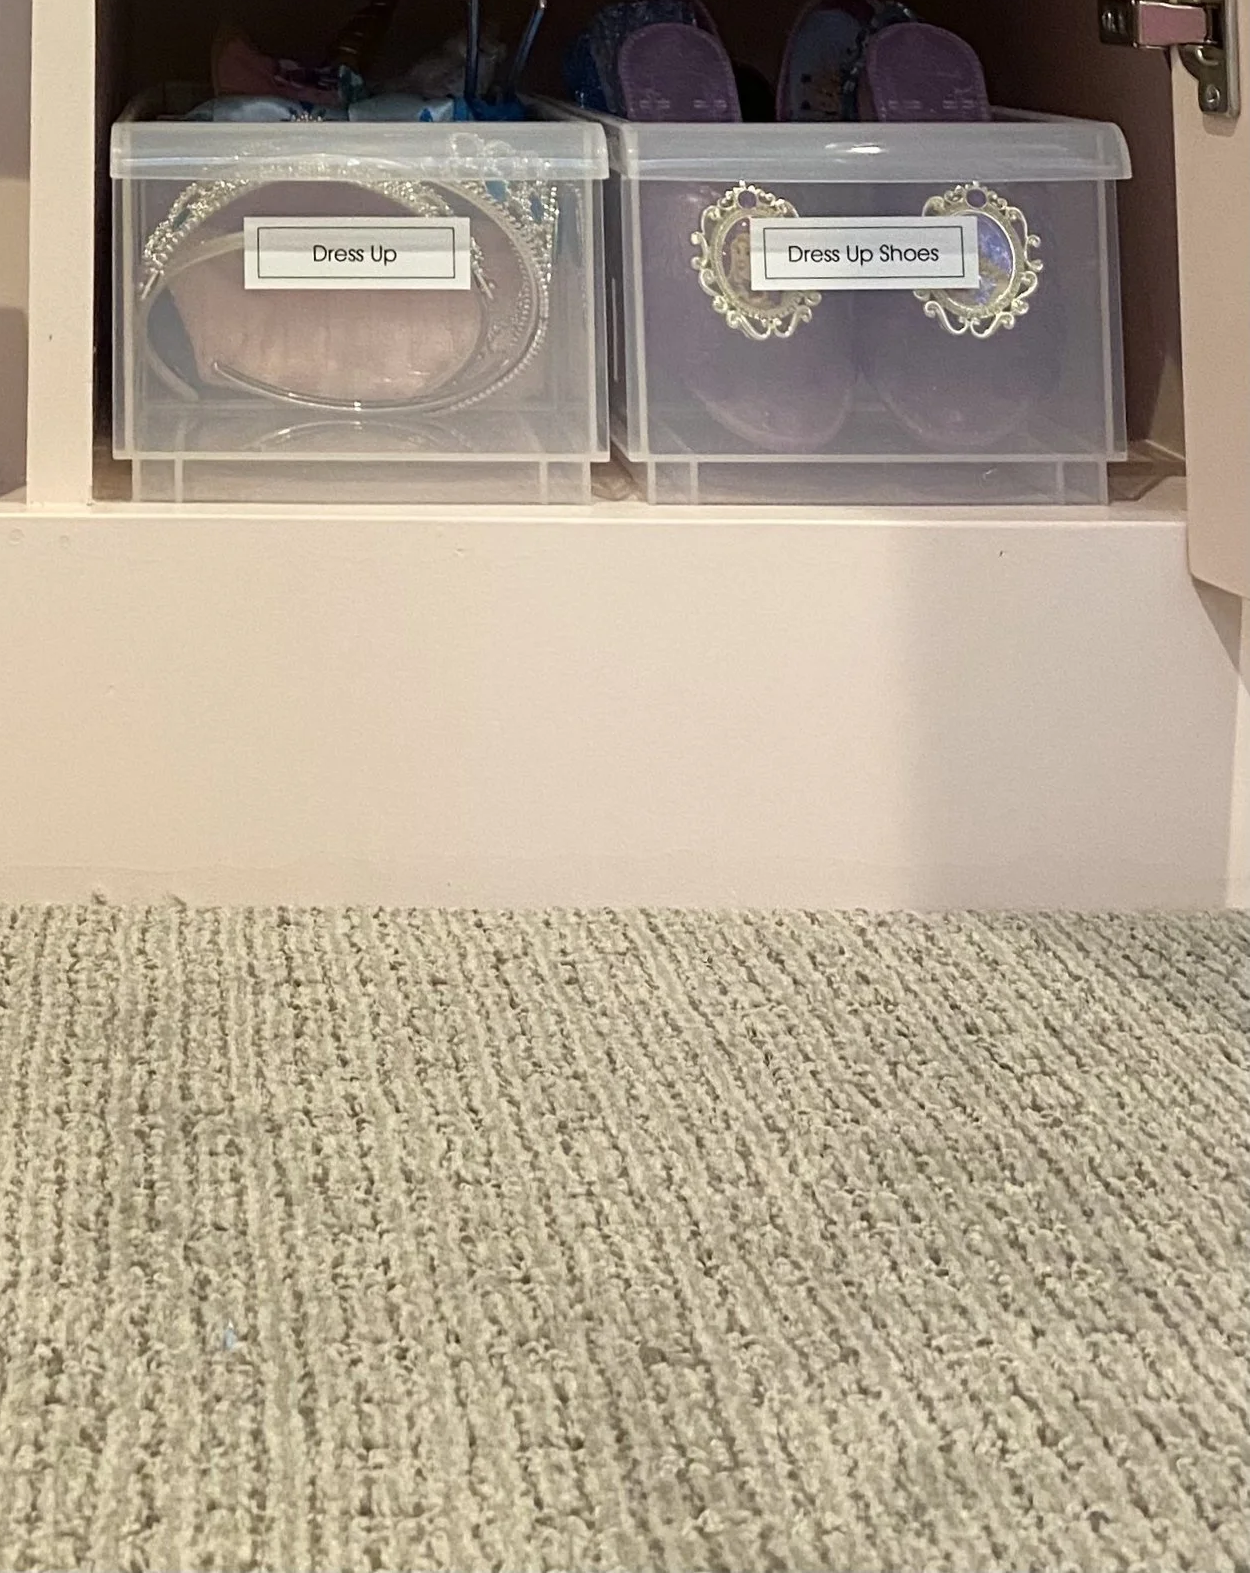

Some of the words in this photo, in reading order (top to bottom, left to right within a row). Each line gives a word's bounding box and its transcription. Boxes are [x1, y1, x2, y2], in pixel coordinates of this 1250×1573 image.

[313, 244, 365, 263] Dress
[371, 244, 398, 267] Up
[788, 245, 841, 263] Dress
[846, 245, 874, 267] Up
[879, 244, 940, 262] Shoes
